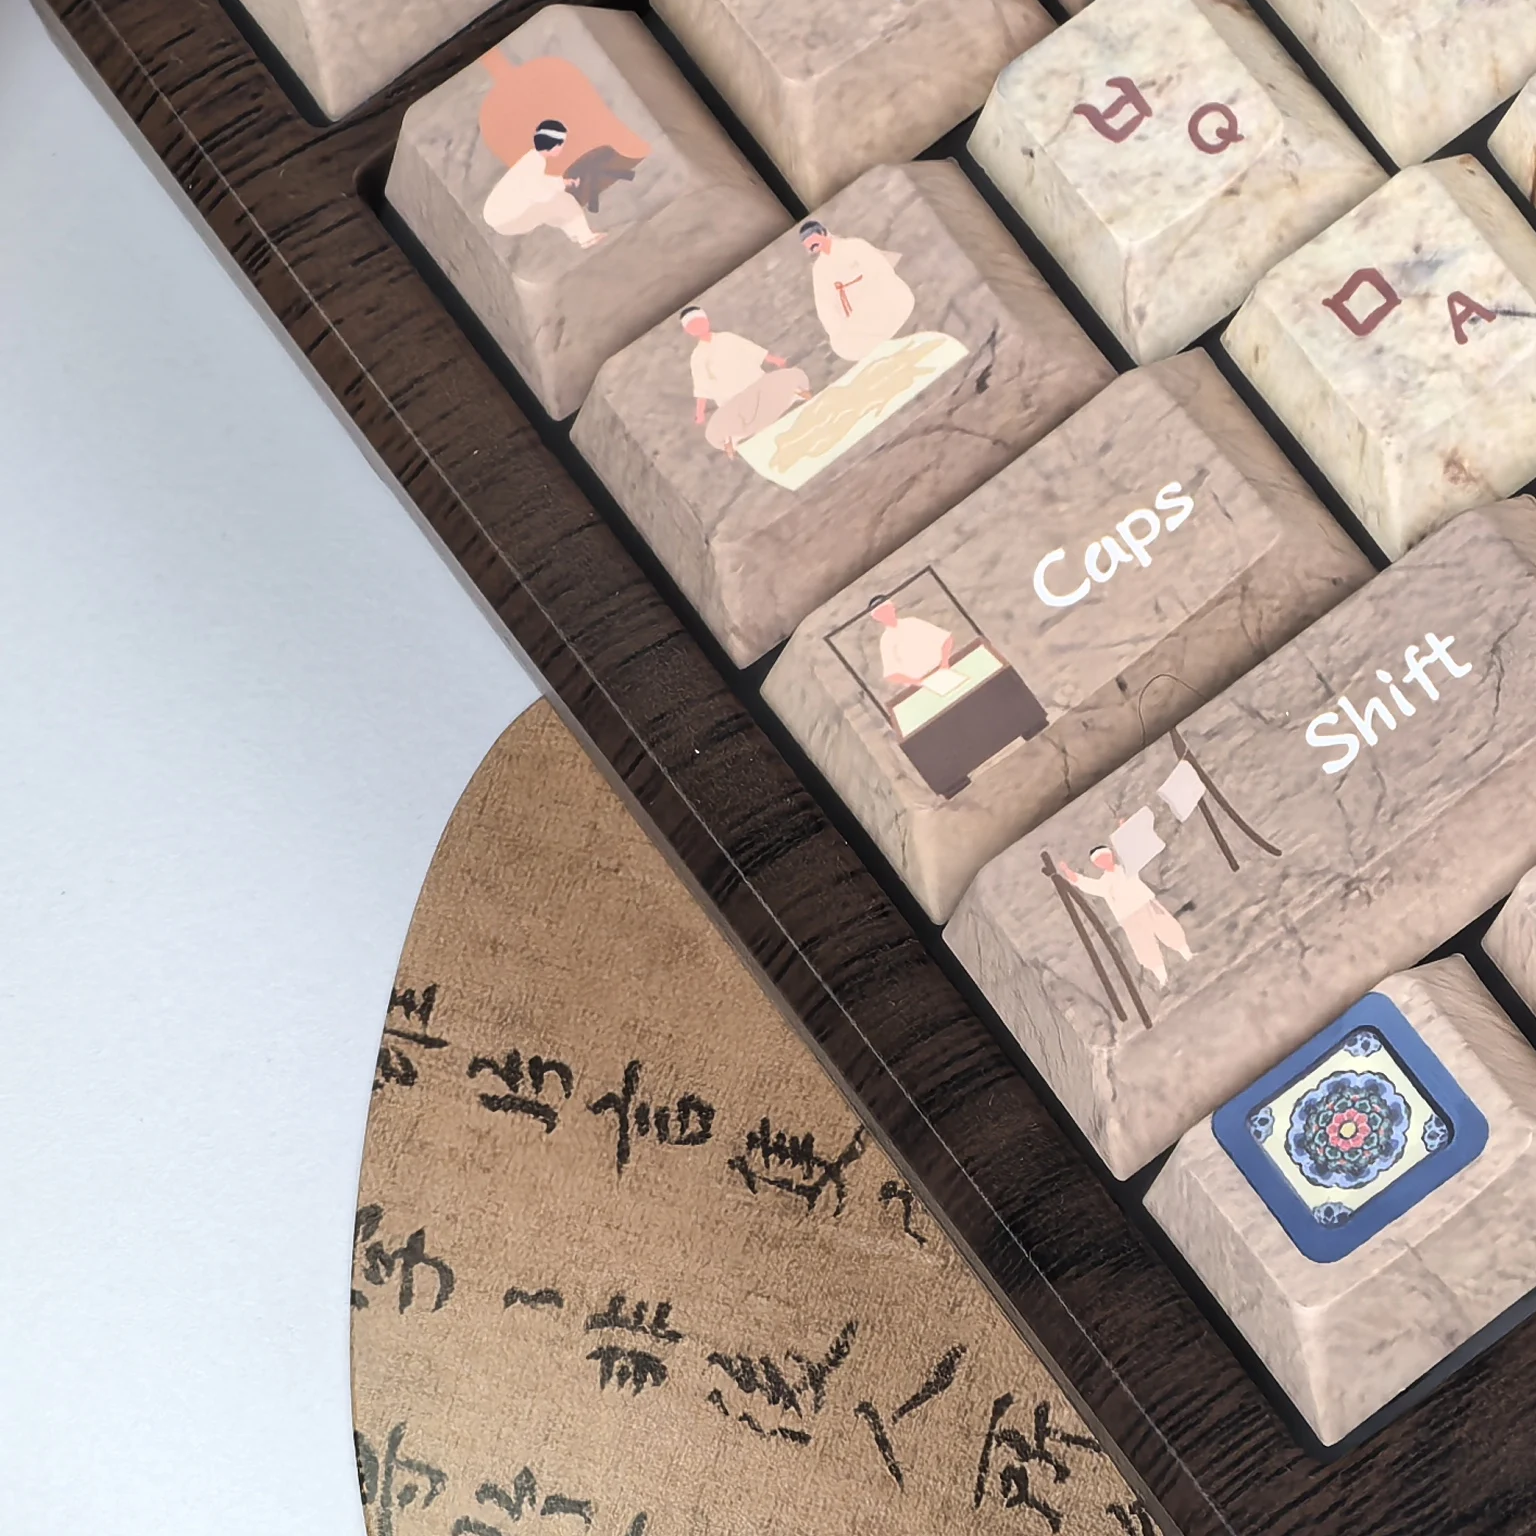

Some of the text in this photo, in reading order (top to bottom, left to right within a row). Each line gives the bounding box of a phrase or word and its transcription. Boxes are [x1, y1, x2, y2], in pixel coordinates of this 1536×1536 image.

[1188, 104, 1243, 155] Q
[1448, 293, 1497, 345] A
[1032, 480, 1195, 608] Caps
[1305, 632, 1473, 775] Shift
